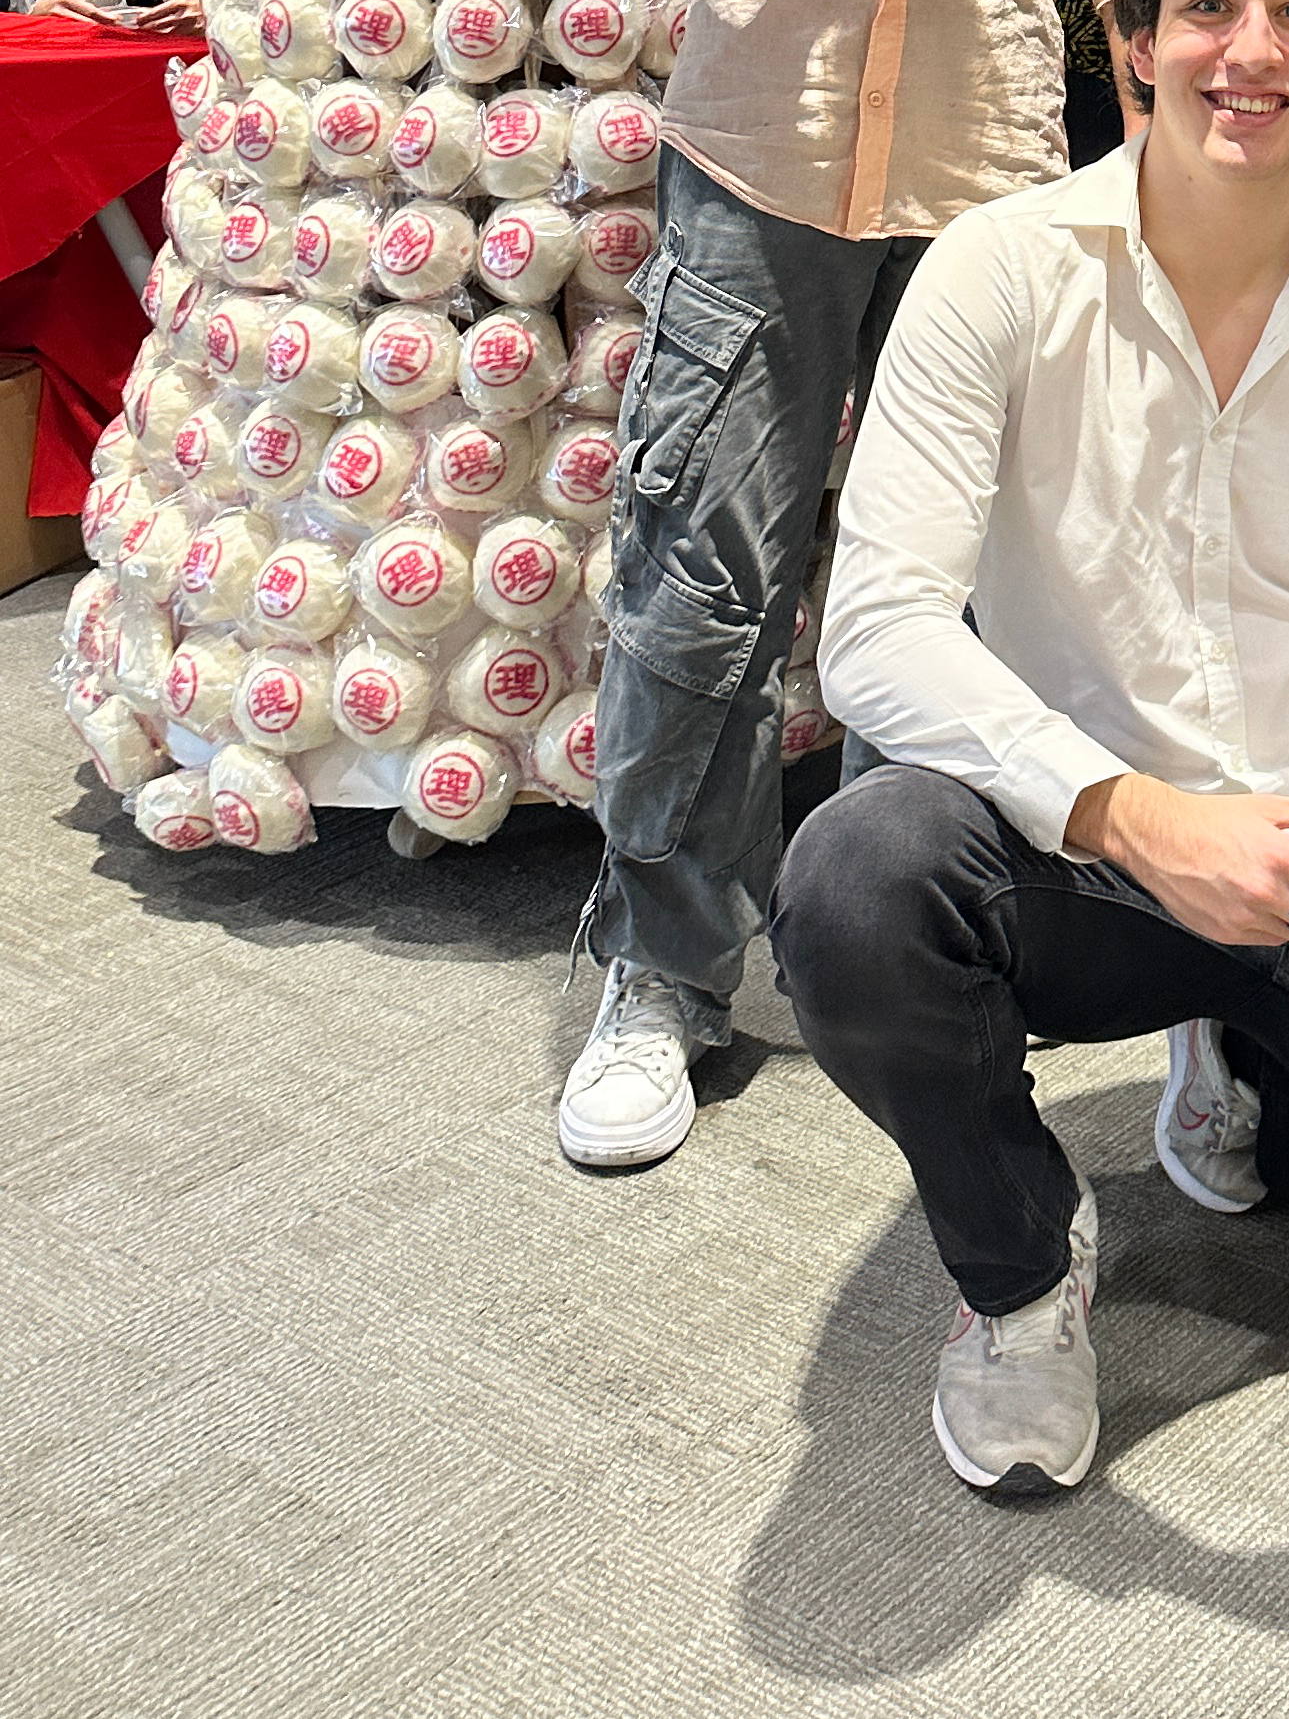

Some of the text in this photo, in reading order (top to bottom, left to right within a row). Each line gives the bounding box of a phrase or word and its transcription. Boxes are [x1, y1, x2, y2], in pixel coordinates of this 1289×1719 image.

[262, 8, 284, 51] 理
[351, 6, 393, 49] 理
[451, 7, 497, 49] 理
[570, 7, 616, 43] 理
[237, 111, 269, 153] 理
[323, 102, 372, 146] 理
[489, 110, 532, 149] 理
[605, 113, 652, 153] 理
[594, 223, 645, 267] 理
[380, 334, 420, 376] 理
[476, 330, 523, 378] 理
[251, 425, 291, 469] 理
[328, 444, 372, 490] 理
[563, 448, 611, 496] 理
[382, 550, 435, 596] 理
[251, 680, 295, 723] 理
[492, 662, 539, 700] 理
[345, 681, 389, 725] 理
[426, 767, 471, 809] 理
